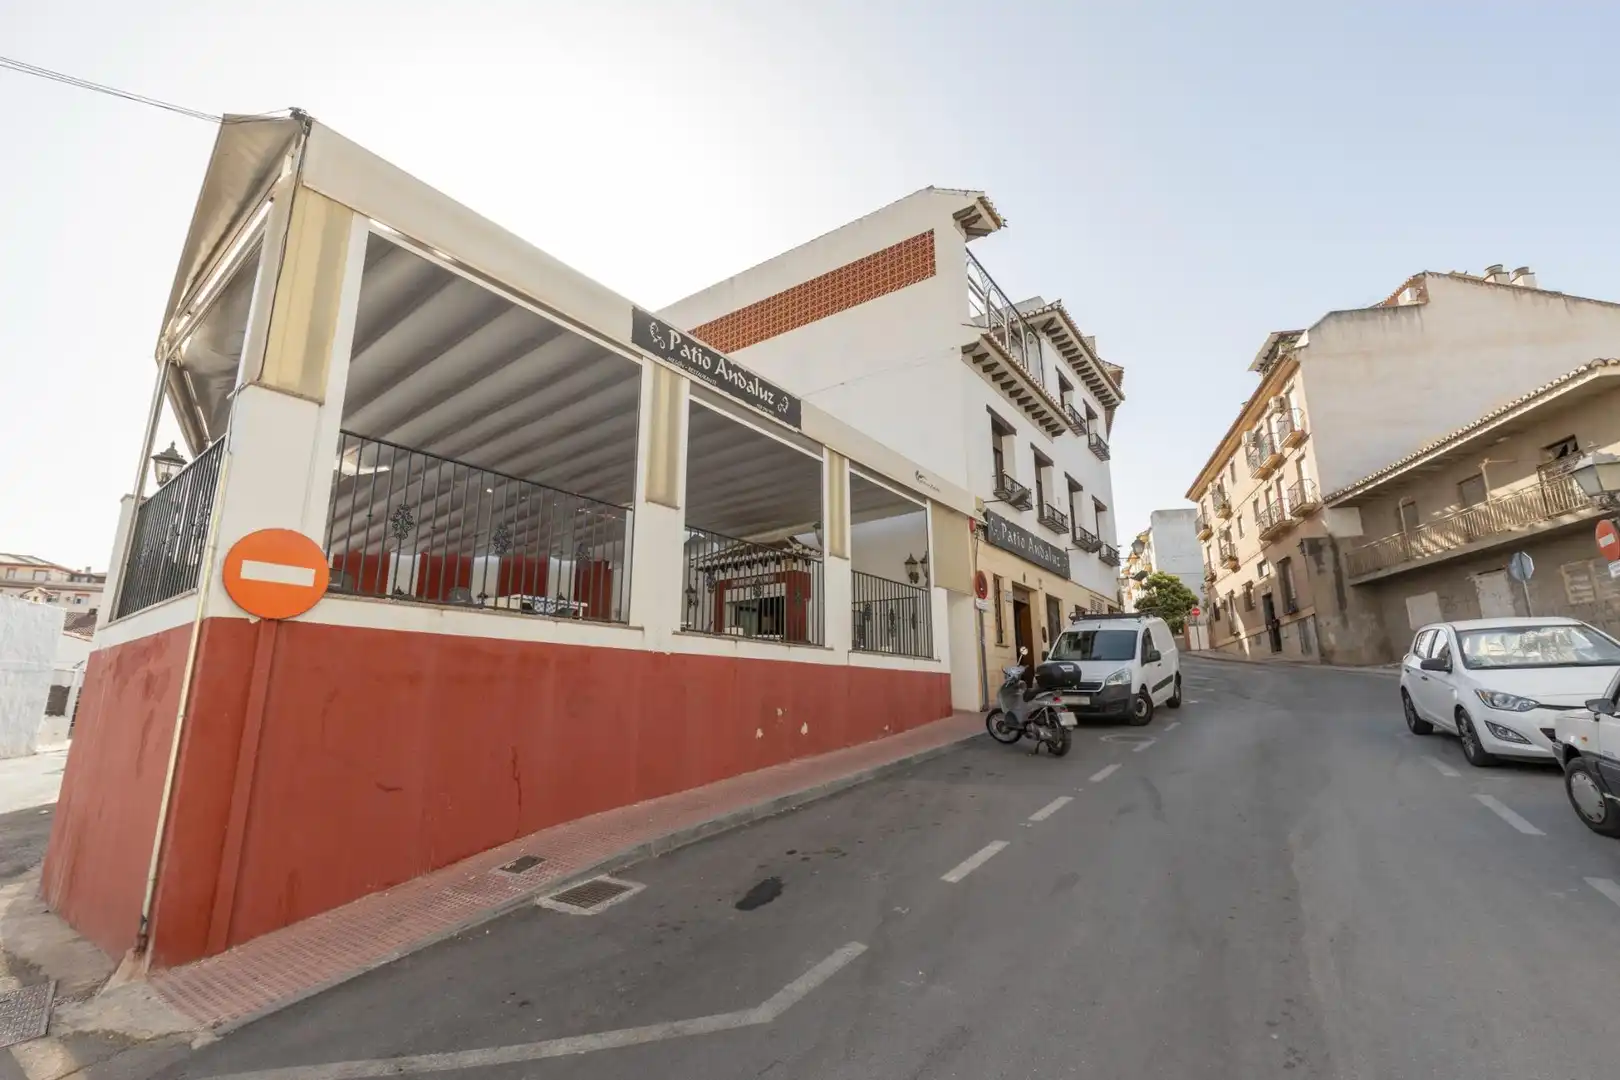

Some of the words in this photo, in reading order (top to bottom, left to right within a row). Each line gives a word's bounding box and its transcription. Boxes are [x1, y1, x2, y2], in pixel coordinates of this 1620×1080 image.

[668, 329, 712, 371] Patio
[714, 358, 776, 405] Andaluz
[1001, 522, 1026, 549] Patio
[1028, 538, 1061, 568] Andaluz
